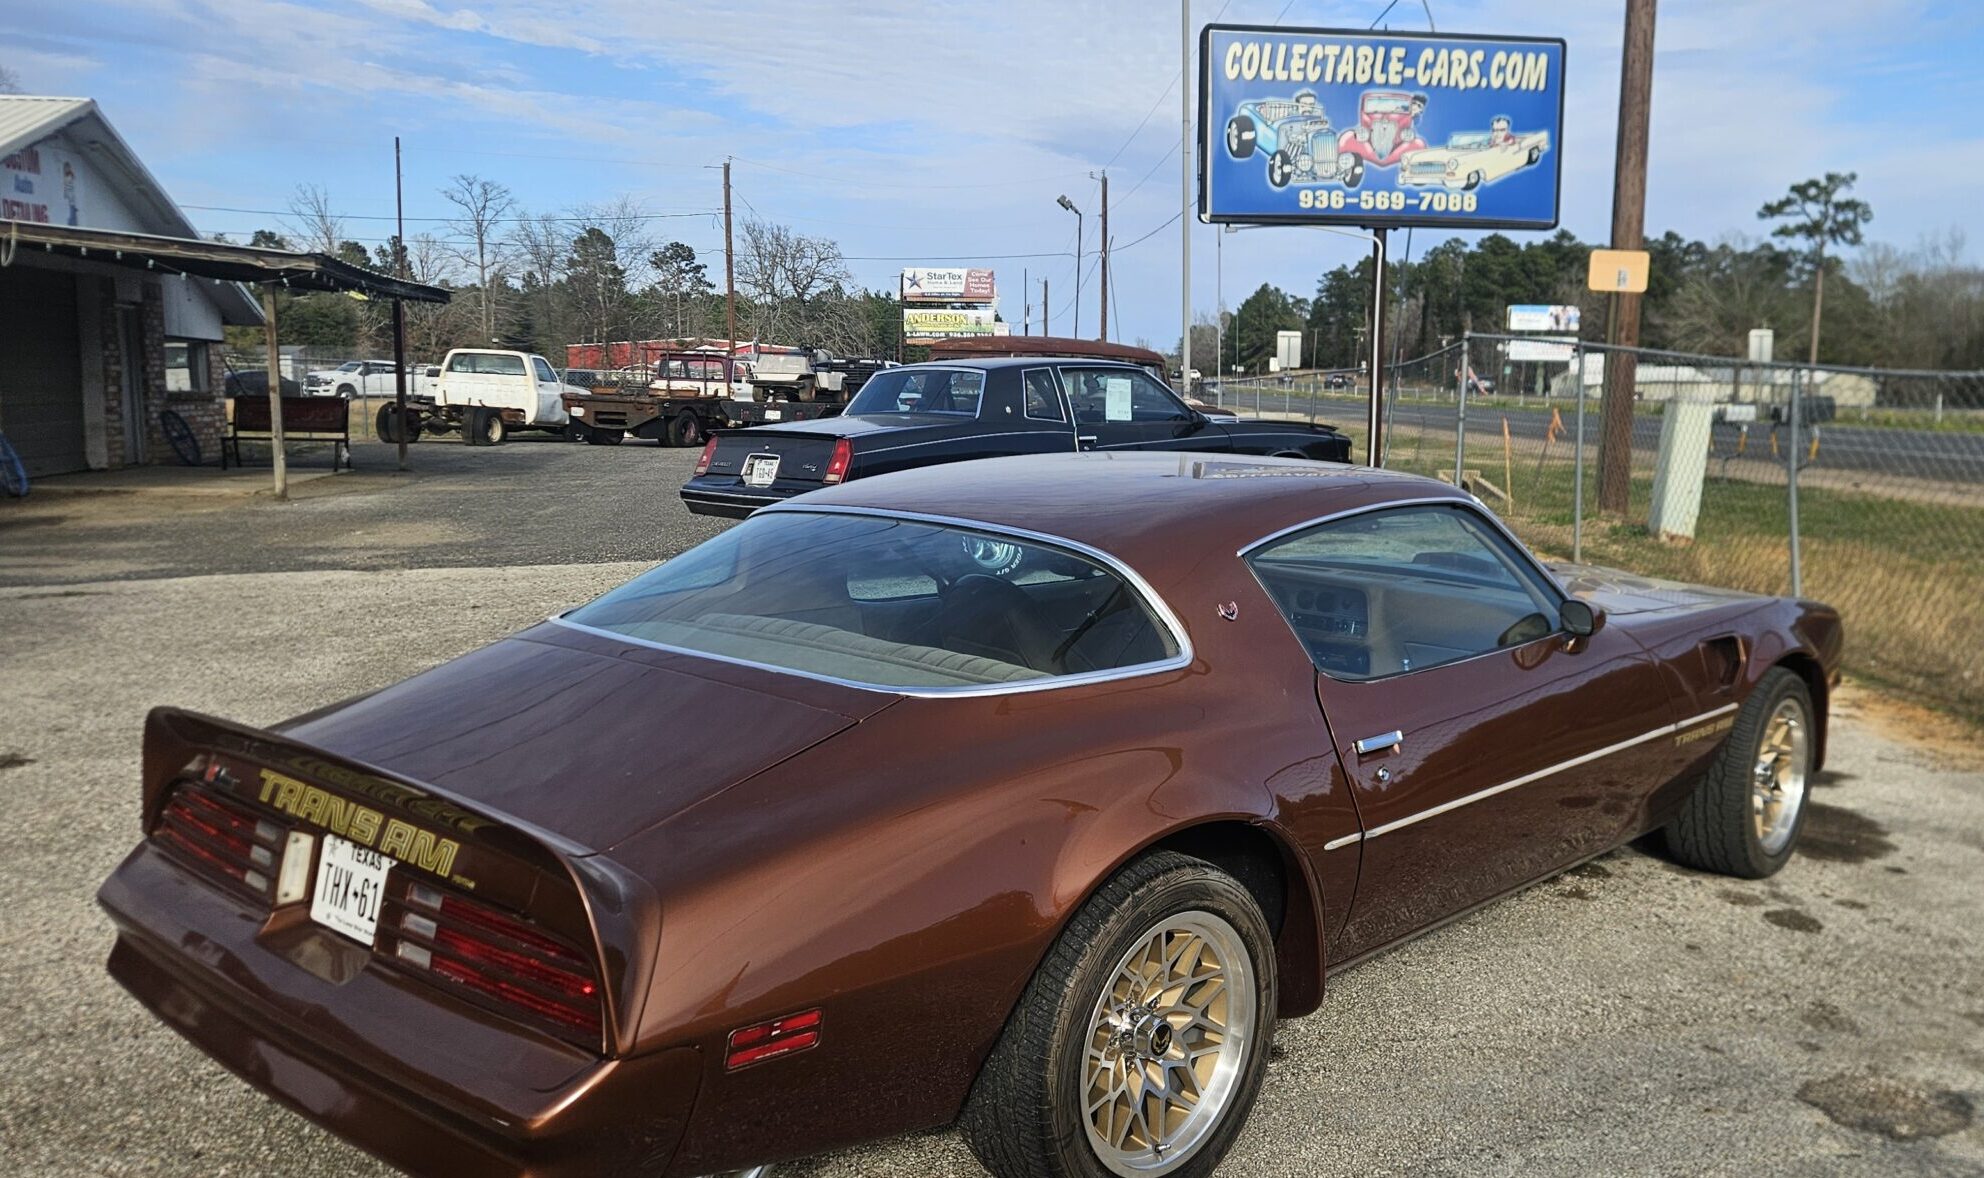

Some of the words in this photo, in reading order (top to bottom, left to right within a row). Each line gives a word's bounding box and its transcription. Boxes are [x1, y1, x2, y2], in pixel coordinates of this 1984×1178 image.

[1225, 41, 1549, 91] COLLECTABLE-CARS.COM
[1298, 189, 1478, 212] 936-569-7088
[926, 272, 962, 281] StarTex
[905, 312, 968, 325] ANDERSON
[258, 768, 384, 847] TRANS
[379, 818, 461, 878] AM
[350, 844, 383, 871] TEXAS
